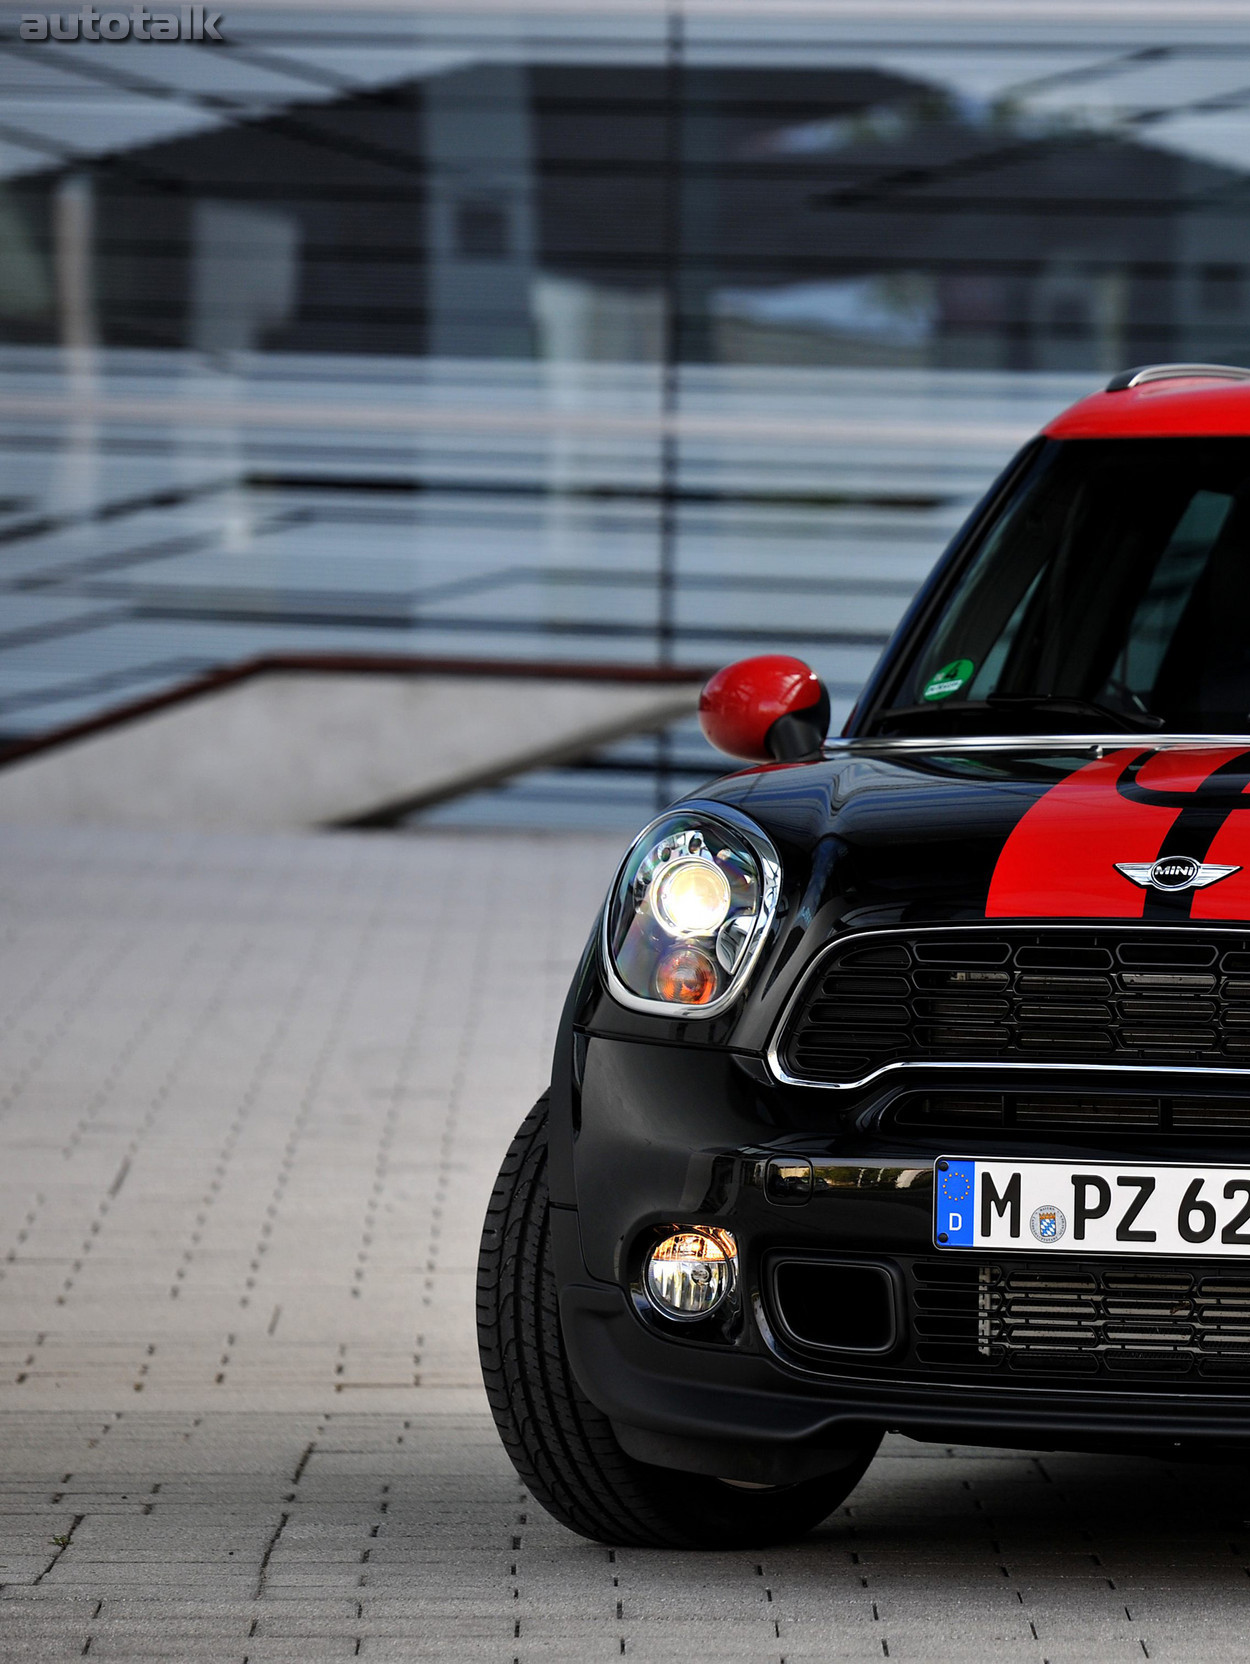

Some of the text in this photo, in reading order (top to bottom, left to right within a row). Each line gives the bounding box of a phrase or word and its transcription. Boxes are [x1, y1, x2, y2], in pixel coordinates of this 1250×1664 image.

[1155, 865, 1195, 876] MINI
[981, 1171, 1021, 1238] M
[1071, 1174, 1156, 1242] PZ
[949, 1212, 962, 1231] D
